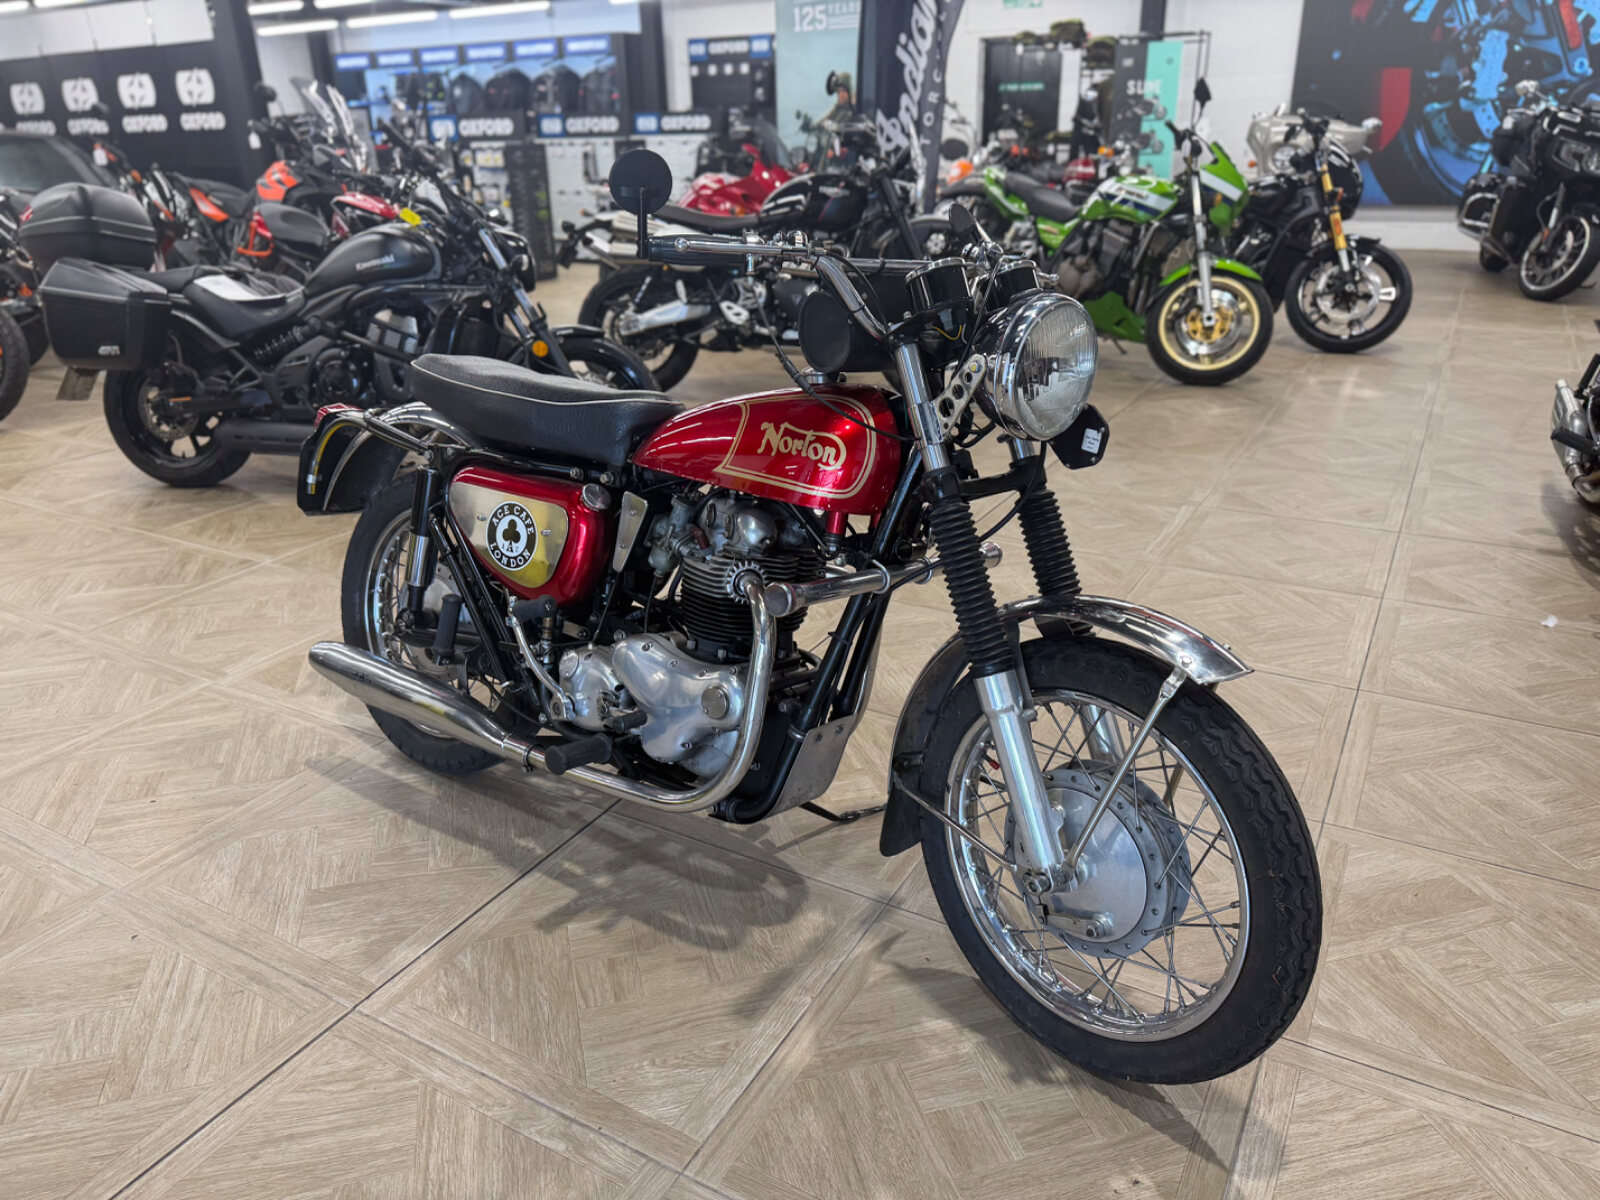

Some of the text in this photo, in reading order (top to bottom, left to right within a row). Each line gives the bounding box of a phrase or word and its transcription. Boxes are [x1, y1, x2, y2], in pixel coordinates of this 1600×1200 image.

[794, 4, 827, 32] 125
[458, 117, 514, 136] OXFORD
[565, 115, 620, 133] OXFORD
[661, 114, 711, 132] OXFORD
[757, 421, 847, 470] Norton
[492, 504, 534, 535] ACE CAFE
[490, 542, 531, 567] LONDON
